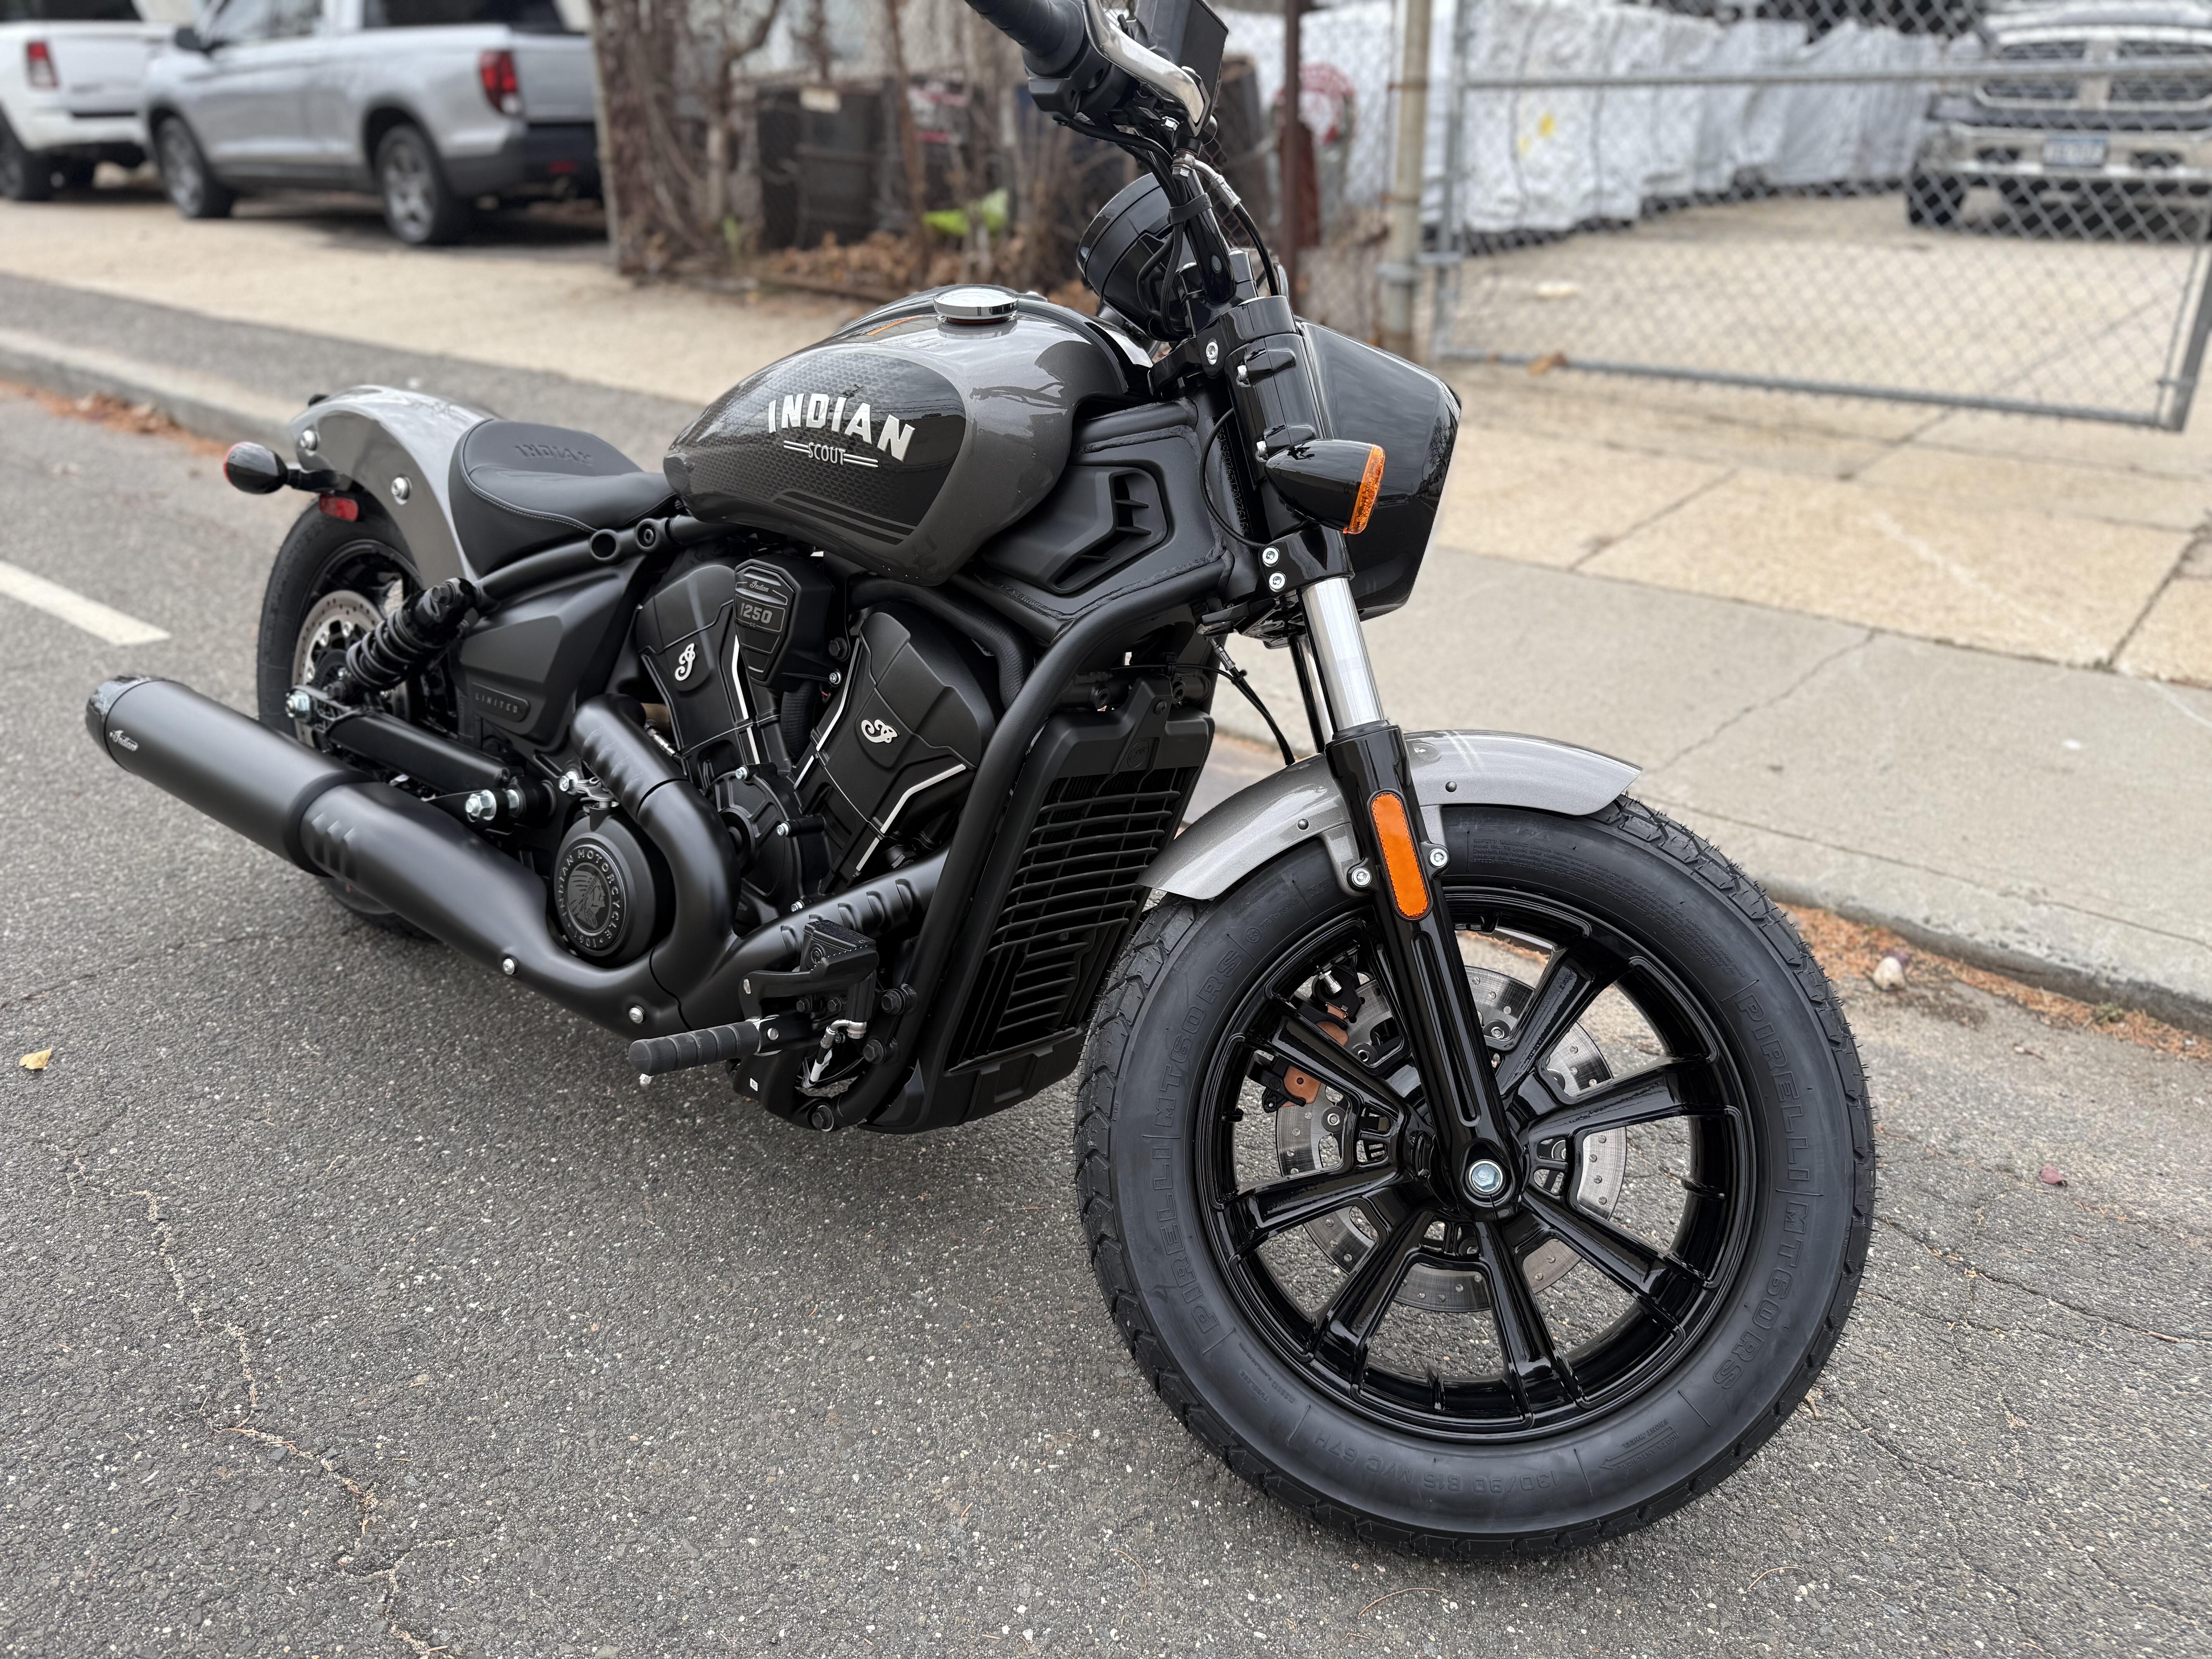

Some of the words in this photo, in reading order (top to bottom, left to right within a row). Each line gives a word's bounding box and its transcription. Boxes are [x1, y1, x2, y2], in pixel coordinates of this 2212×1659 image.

[768, 393, 915, 463] INDIAN
[808, 442, 846, 465] SCOUT
[750, 581, 769, 592] Indian
[740, 603, 772, 623] 1250
[476, 692, 518, 713] LIMITED
[110, 730, 139, 751] Indian
[558, 855, 574, 916] INDIAN
[577, 848, 620, 939] MOTORCYCLE
[1738, 993, 1810, 1182] PIRELLI
[1152, 1146, 1219, 1333] PIRELLI
[1645, 1418, 1669, 1436] FRONT
[1312, 1429, 1359, 1463] 67H
[1620, 1432, 1646, 1450] WHEEL
[1363, 1453, 1413, 1484] M/C
[1472, 1469, 1558, 1493] 130/90
